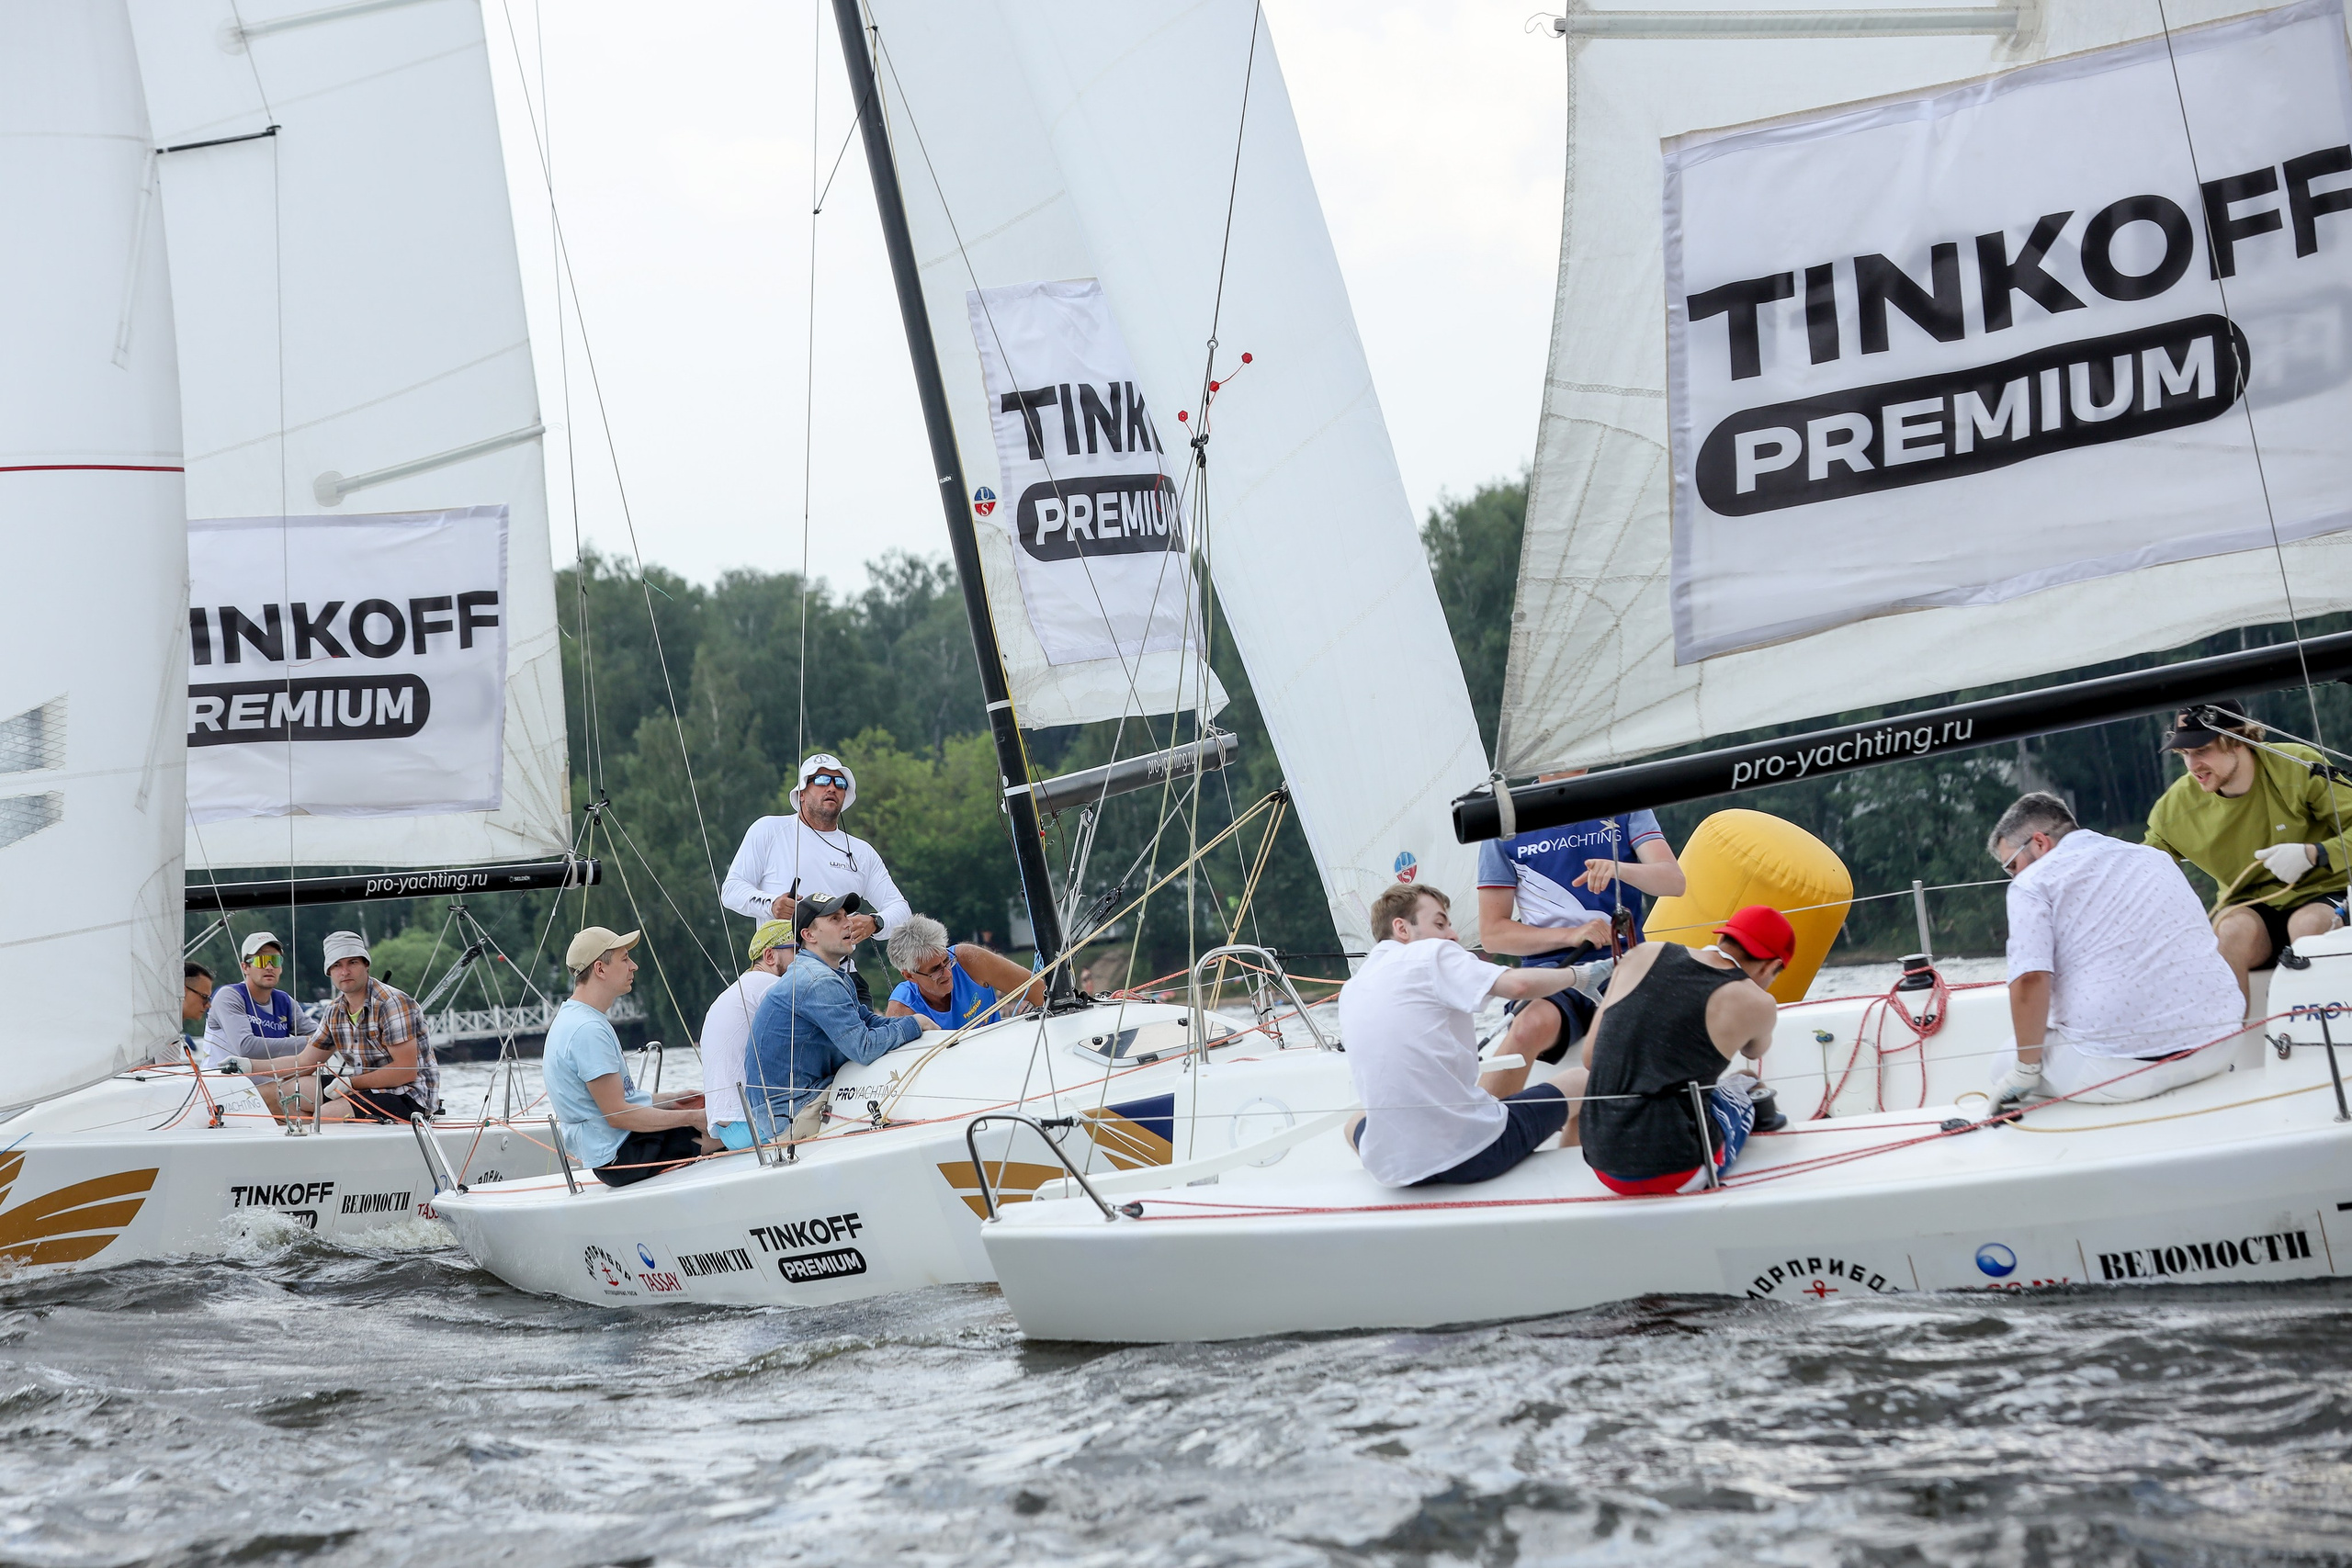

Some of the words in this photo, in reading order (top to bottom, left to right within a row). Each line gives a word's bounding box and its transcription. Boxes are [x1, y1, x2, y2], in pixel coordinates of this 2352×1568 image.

[1687, 144, 2352, 381] TINKOFF
[1001, 381, 1164, 461] TINK
[1734, 334, 2216, 495] PREMIUM
[189, 591, 499, 665] INKOFF
[187, 686, 414, 734] REMIUM
[1732, 718, 1973, 790] pro-yachting.ru
[1517, 829, 1622, 859] PROYACHTING
[366, 872, 488, 897] pro-yachting.ru
[224, 1098, 261, 1112] YACHTING
[231, 1181, 334, 1208] TINKOFF
[341, 1191, 412, 1215] ВЕДОМОСТИ
[749, 1213, 864, 1253] TINKOFF
[677, 1247, 754, 1278] ВЕДОМОСТИ
[782, 1252, 862, 1280] PREMIUM
[2098, 1230, 2312, 1281] ВЕДОМОСТИ
[639, 1272, 683, 1292] TASSAY
[1746, 1258, 1899, 1299] МОРПРИБО
